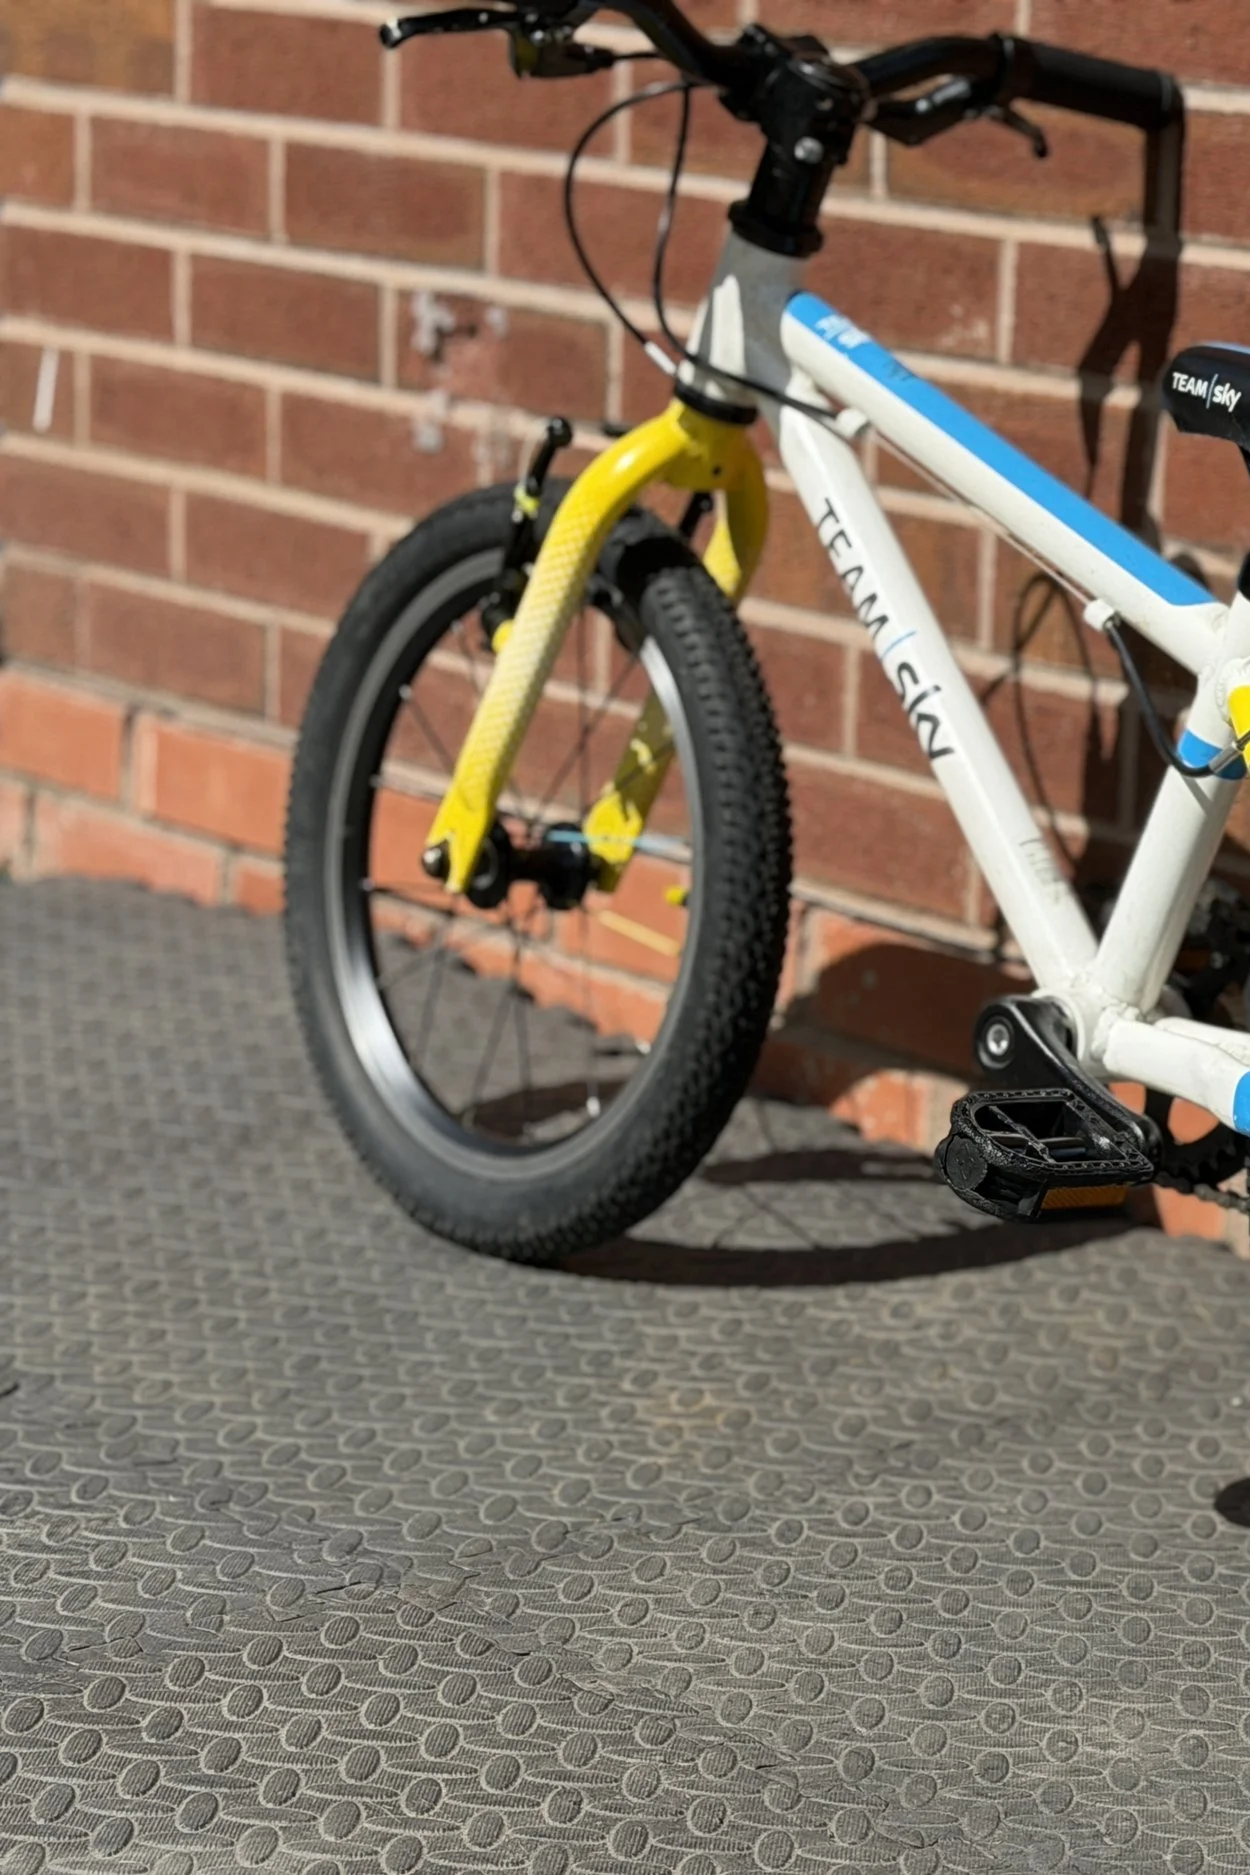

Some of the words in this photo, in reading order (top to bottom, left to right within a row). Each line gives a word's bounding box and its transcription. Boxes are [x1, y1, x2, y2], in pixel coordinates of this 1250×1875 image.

[1172, 371, 1209, 400] TEAM
[1212, 382, 1242, 413] sky
[817, 497, 890, 641] TEAM
